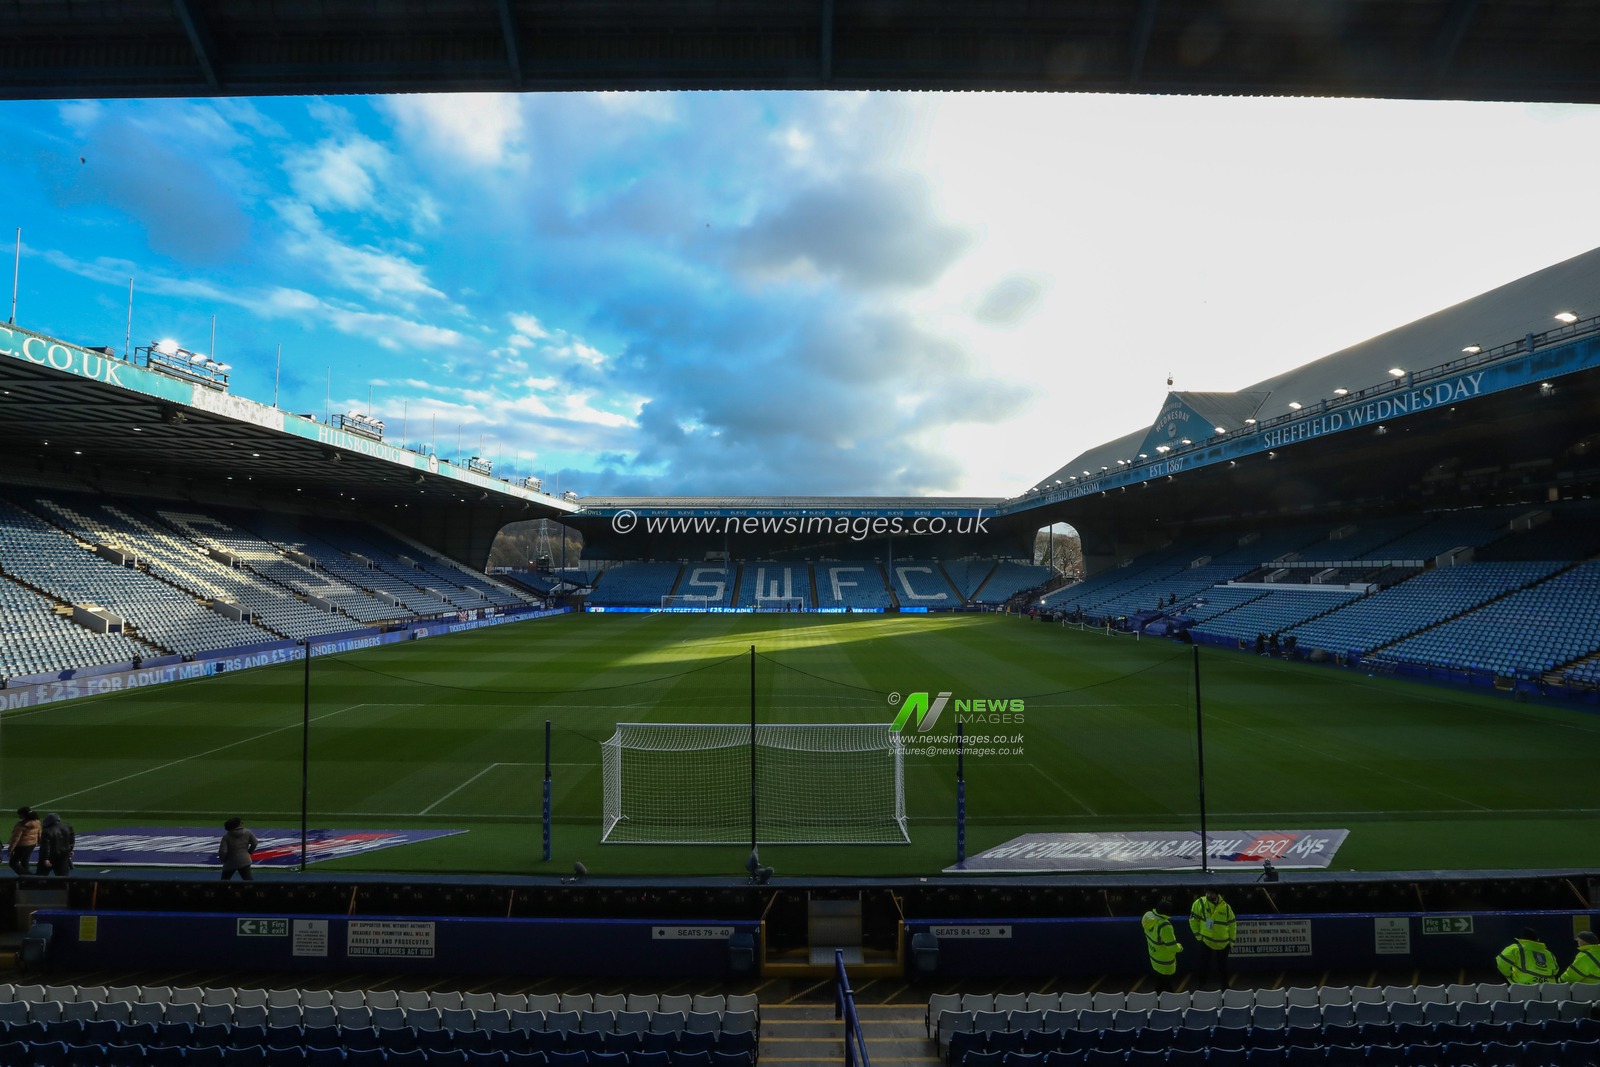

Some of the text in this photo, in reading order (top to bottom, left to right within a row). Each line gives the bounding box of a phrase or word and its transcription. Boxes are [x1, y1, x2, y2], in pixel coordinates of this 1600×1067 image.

[1155, 410, 1191, 433] WEDNESDAY
[1263, 371, 1485, 449] SHEFFIELD WEDNESDAY
[318, 426, 404, 466] HILLSBOROUG
[1149, 457, 1184, 478] EST. 1867
[36, 680, 80, 705] £25
[87, 677, 123, 696] FOR
[127, 667, 176, 689] ADULT
[244, 654, 268, 669] AND
[271, 648, 286, 664] £5
[338, 642, 346, 652] 11
[347, 636, 381, 651] MEMBERS
[678, 929, 702, 937] SEATS
[704, 929, 712, 937] 79
